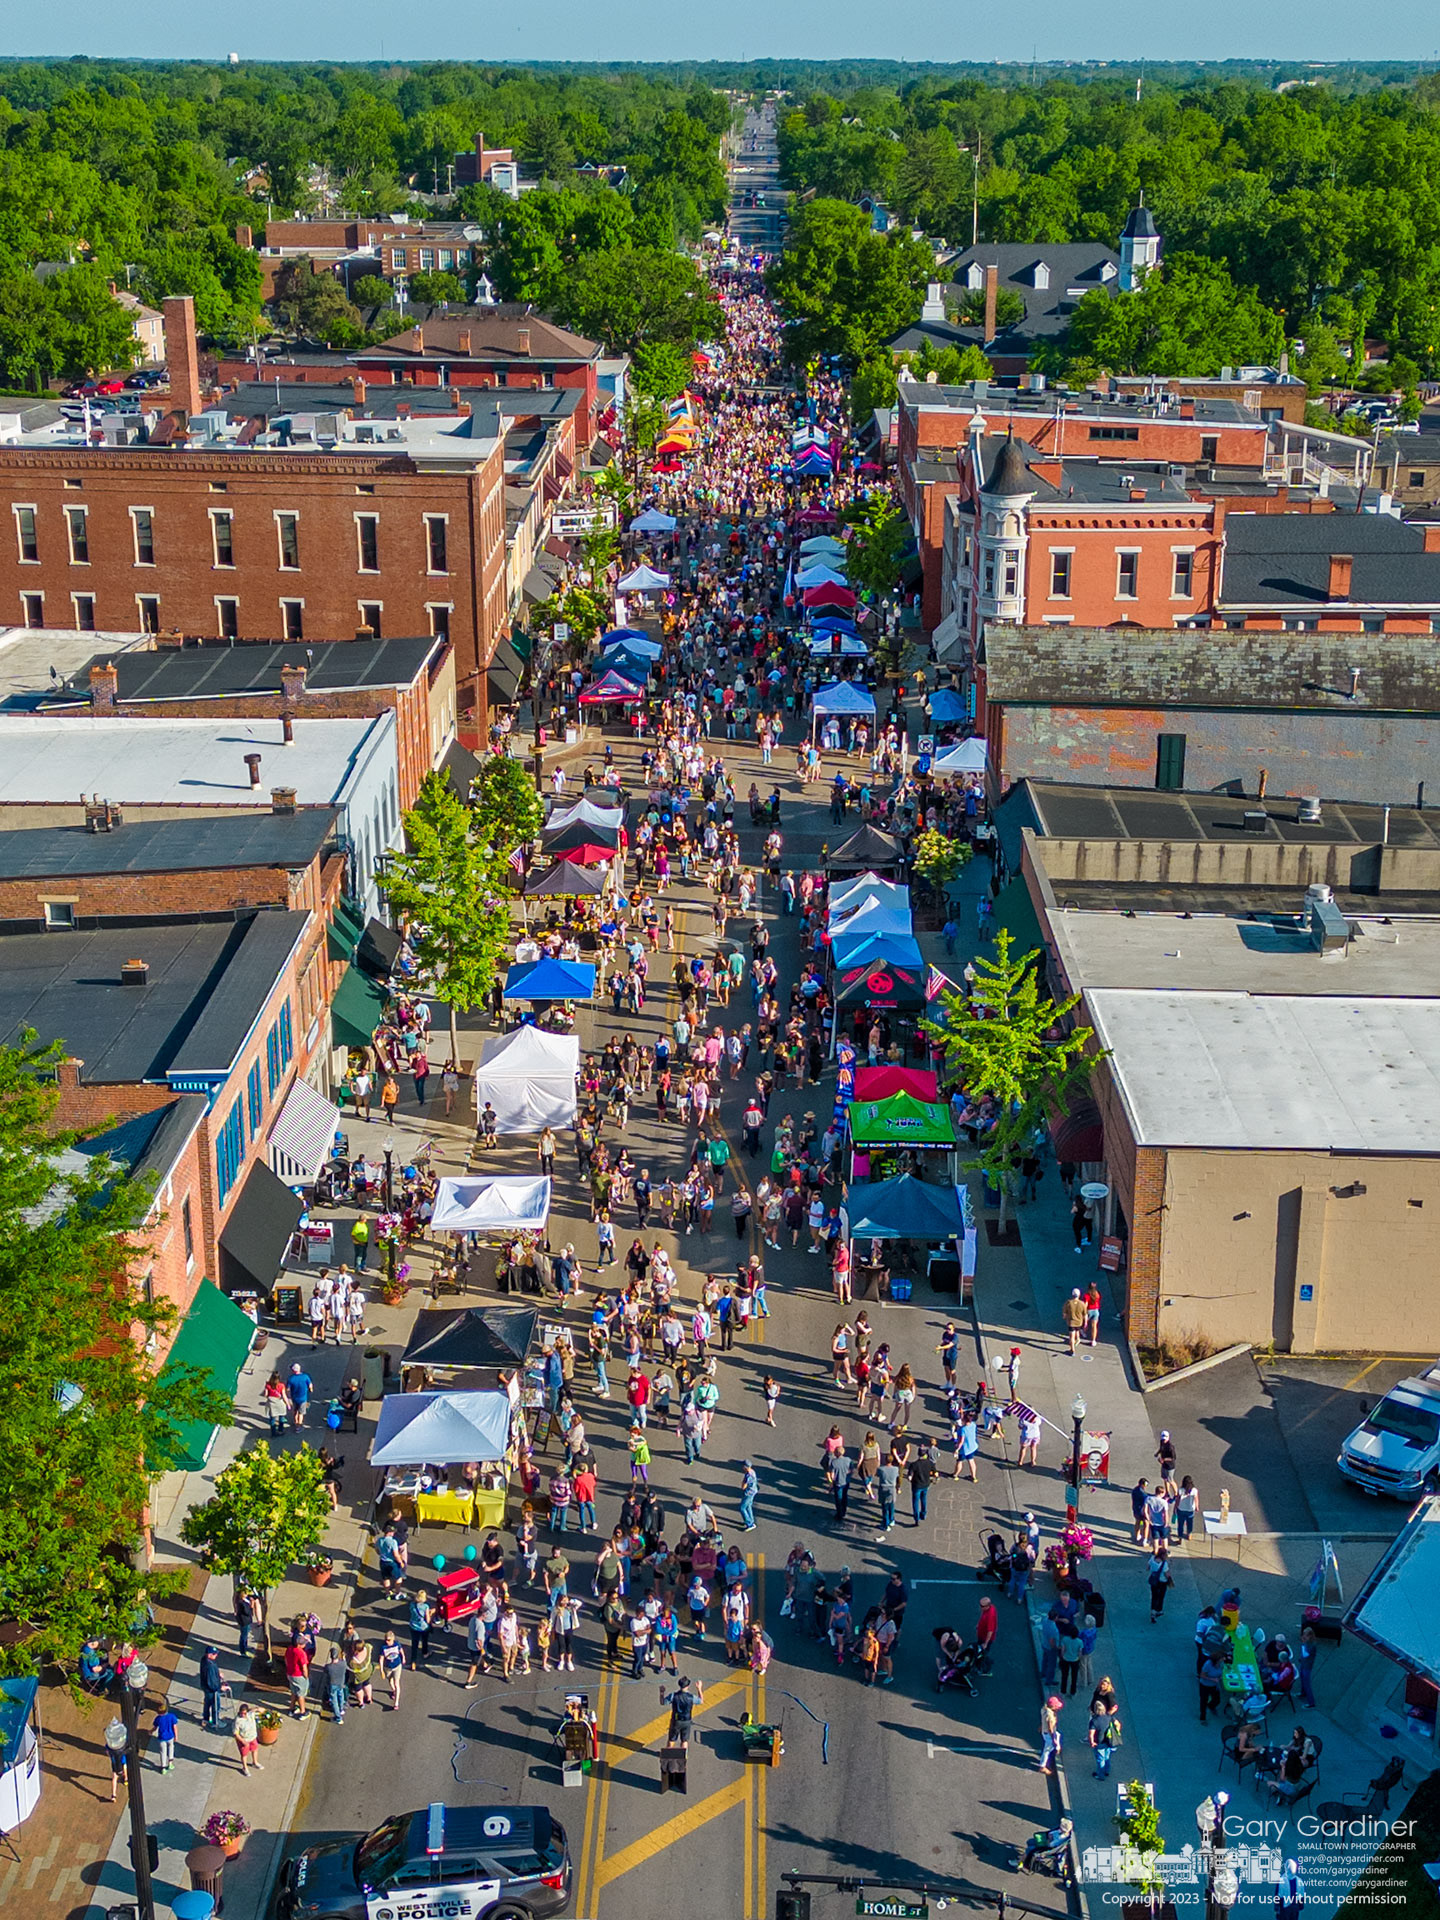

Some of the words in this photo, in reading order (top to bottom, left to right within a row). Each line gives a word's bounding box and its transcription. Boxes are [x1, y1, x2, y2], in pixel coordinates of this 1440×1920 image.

[396, 1899, 471, 1912] WESTERVILLE
[398, 1905, 472, 1920] POLICE
[863, 1902, 906, 1916] HOME
